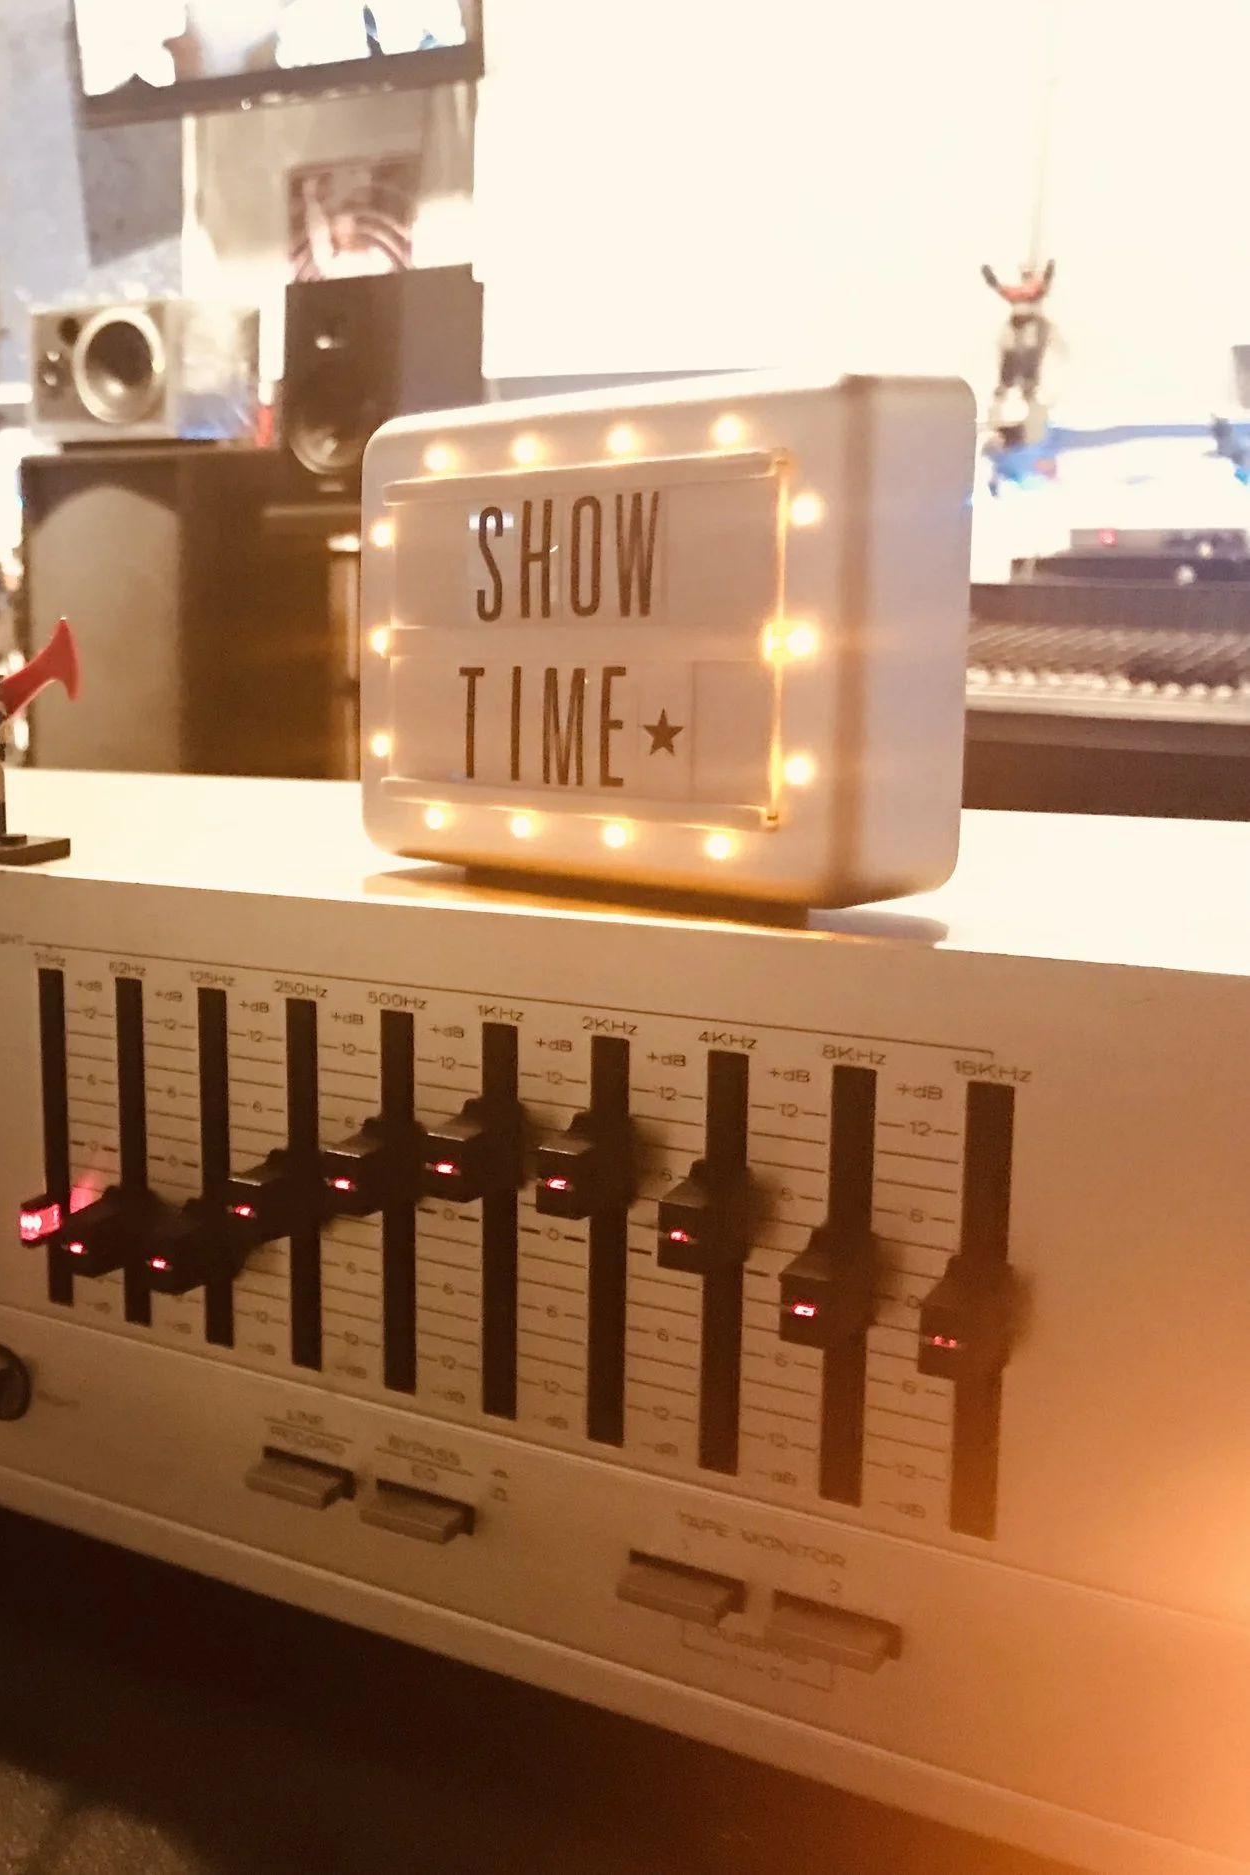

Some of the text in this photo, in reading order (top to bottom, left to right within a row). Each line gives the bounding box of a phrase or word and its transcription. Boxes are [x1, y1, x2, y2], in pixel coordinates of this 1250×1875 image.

[475, 490, 660, 622] SHOW
[458, 665, 628, 788] TIME
[190, 971, 236, 987] 125Hz
[274, 980, 328, 999] 250Hz
[366, 991, 428, 1010] 500Hz
[478, 1004, 524, 1022] 1KHz
[582, 1016, 639, 1036] 2KHz
[248, 1029, 264, 1042] 12
[698, 1031, 759, 1050] 4KHz
[342, 1042, 358, 1056] 12
[821, 1043, 887, 1066] 8KHz
[439, 1056, 456, 1070] 12
[953, 1059, 1033, 1083] 16KHz
[546, 1071, 563, 1086] 12
[657, 1086, 677, 1101] 12
[778, 1103, 799, 1119] 12
[909, 1120, 932, 1137] 12
